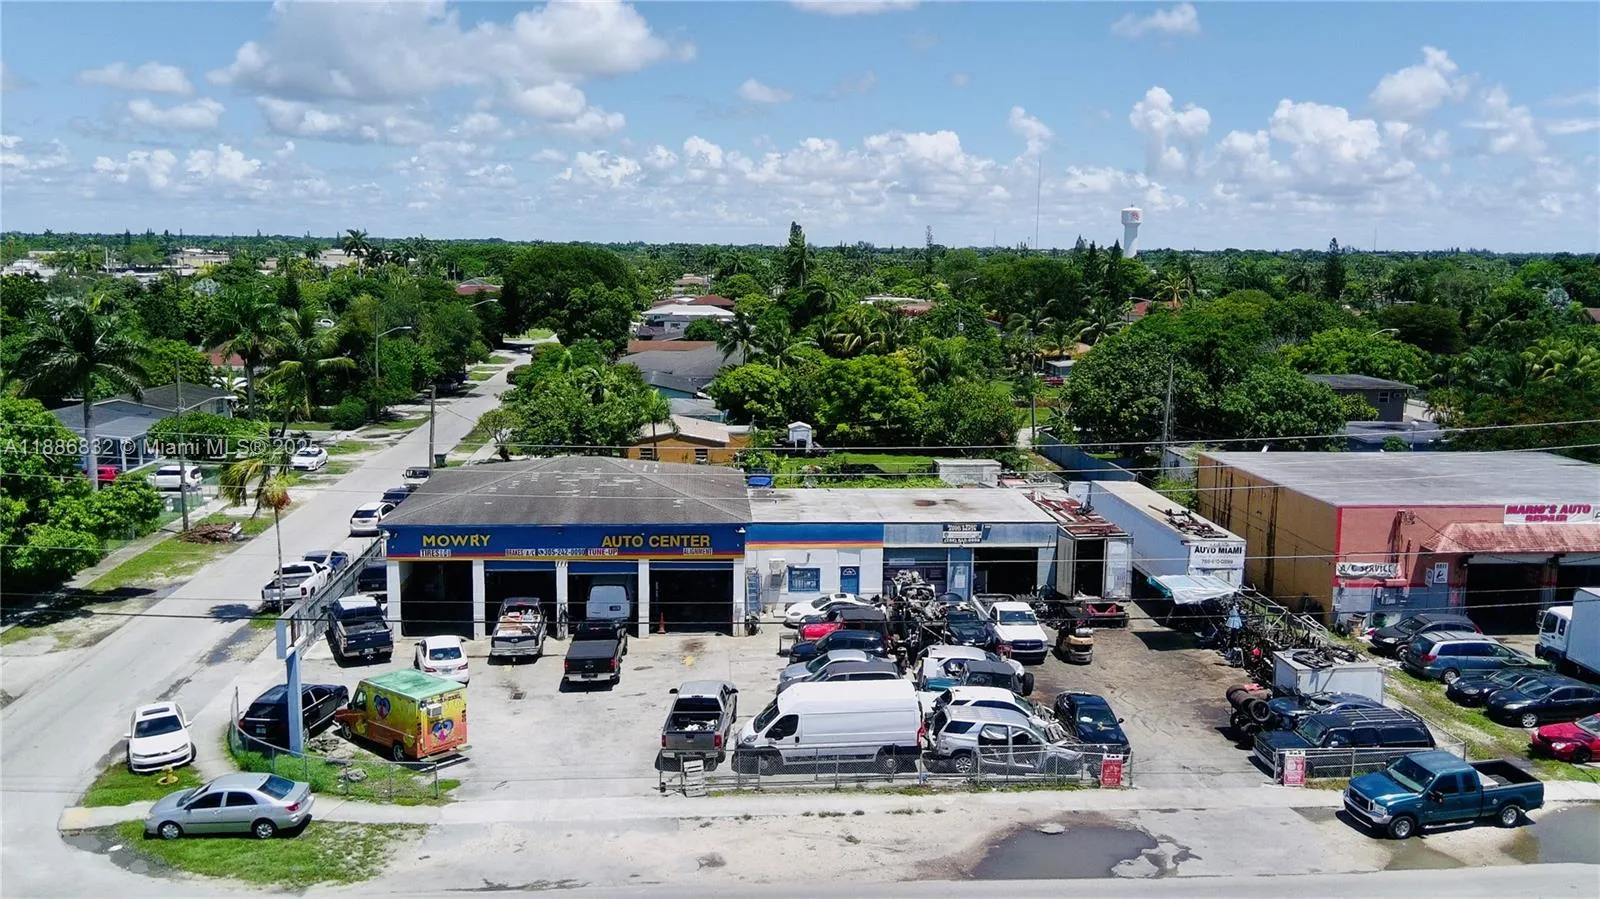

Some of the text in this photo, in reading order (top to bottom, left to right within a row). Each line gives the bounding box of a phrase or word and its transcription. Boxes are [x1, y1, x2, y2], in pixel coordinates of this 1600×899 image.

[1559, 504, 1592, 514] AUTO
[422, 534, 490, 547] MOWRY
[602, 535, 710, 547] AUTO CENTER
[1194, 545, 1242, 554] AUTO MIAMI
